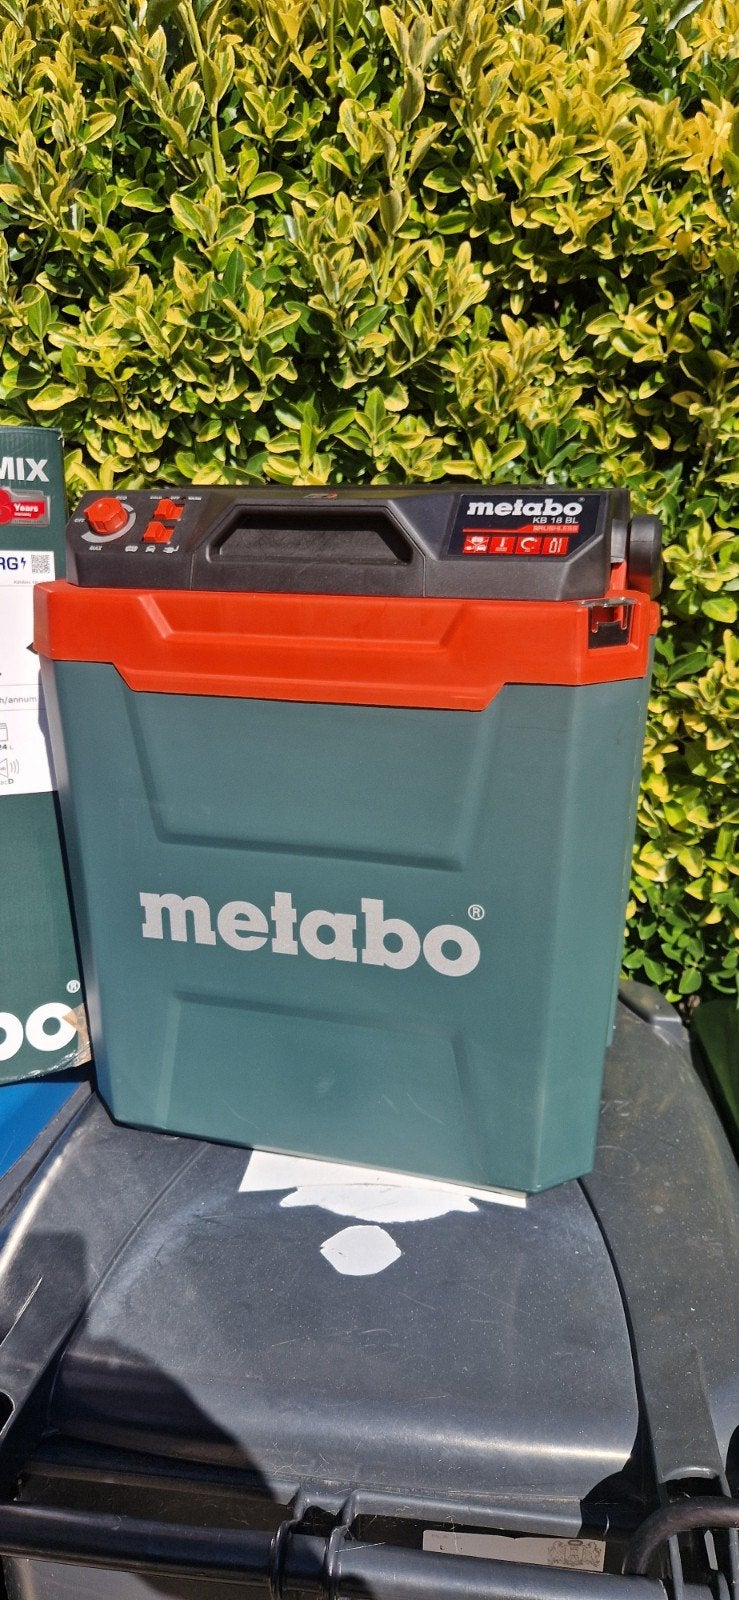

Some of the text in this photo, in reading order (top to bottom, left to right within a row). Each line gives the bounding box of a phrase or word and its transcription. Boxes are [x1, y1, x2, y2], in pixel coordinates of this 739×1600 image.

[0, 456, 49, 482] MIX
[13, 503, 38, 512] Years
[466, 498, 583, 516] metabo
[532, 516, 579, 524] KB 18 BL
[139, 891, 481, 977] metabo
